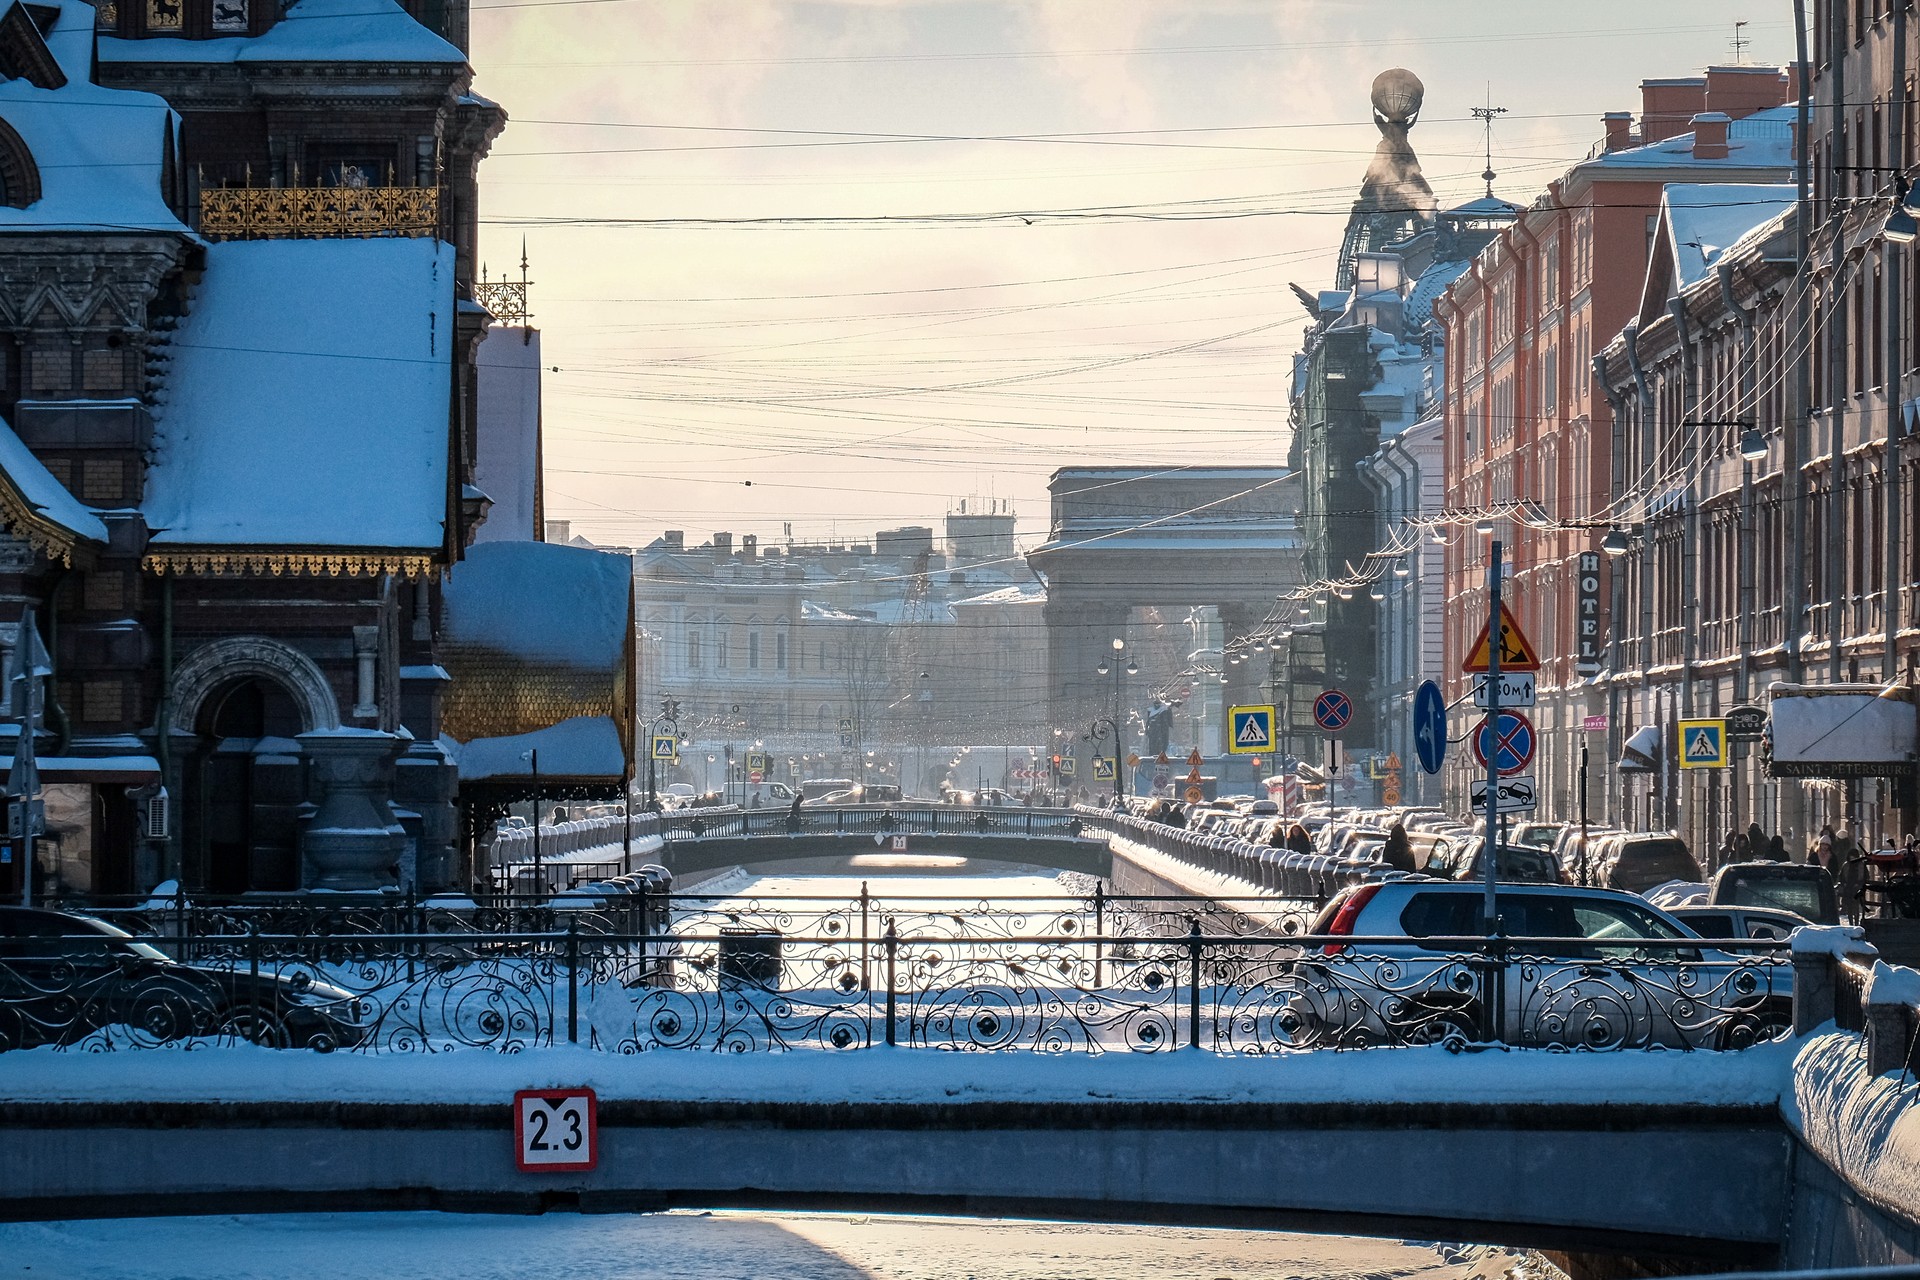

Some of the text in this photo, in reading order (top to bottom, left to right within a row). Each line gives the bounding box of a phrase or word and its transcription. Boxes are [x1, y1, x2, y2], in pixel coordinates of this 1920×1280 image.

[1581, 555, 1599, 657] HOTEL
[1785, 763, 1911, 775] SAINT-PETERSBURG
[1188, 791, 1199, 799] 40
[529, 1109, 583, 1151] 2.3
